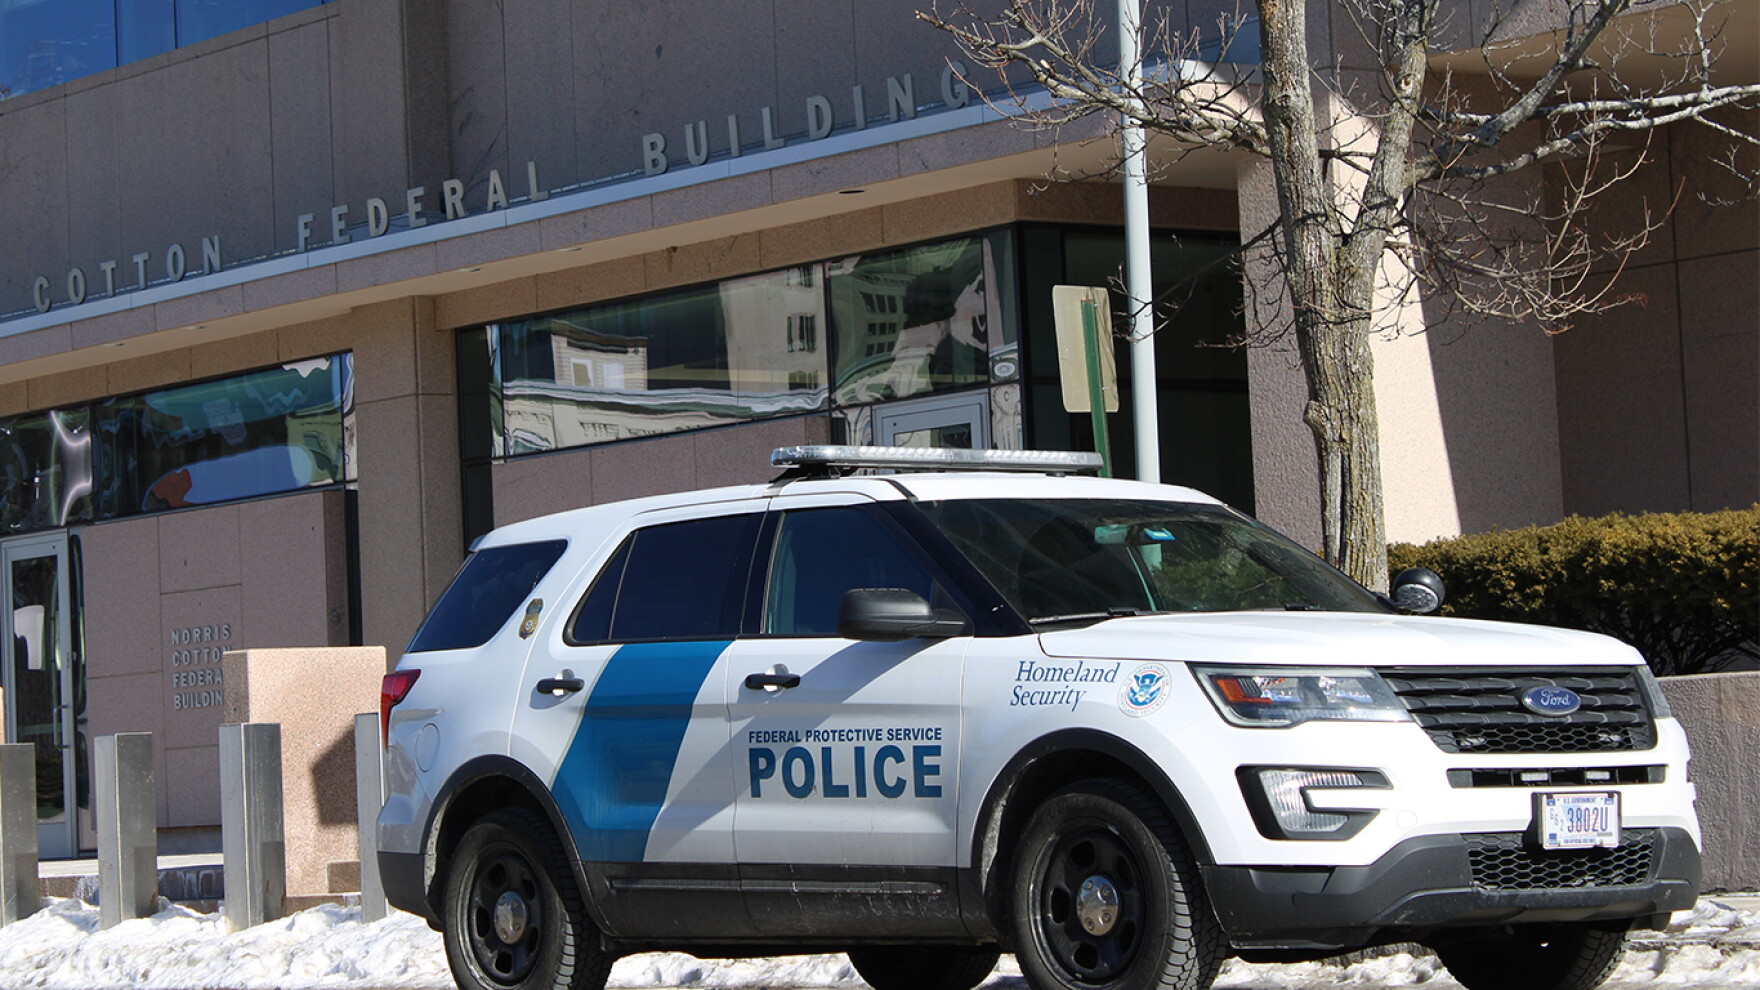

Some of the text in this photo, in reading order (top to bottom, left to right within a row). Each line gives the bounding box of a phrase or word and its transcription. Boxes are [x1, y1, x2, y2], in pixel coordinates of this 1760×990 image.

[33, 61, 970, 313] COTTON FEDERAL BUILDING
[172, 625, 231, 645] NORRIS
[173, 667, 224, 688] FEDERA
[1015, 660, 1121, 683] Homeland
[174, 690, 224, 709] BUILDIN
[1010, 685, 1087, 712] Security
[1540, 690, 1570, 706] Ford
[749, 727, 942, 743] FEDERAL PROTECTIVE SERVICE
[749, 745, 942, 799] POLICE
[1567, 806, 1608, 833] 3802U
